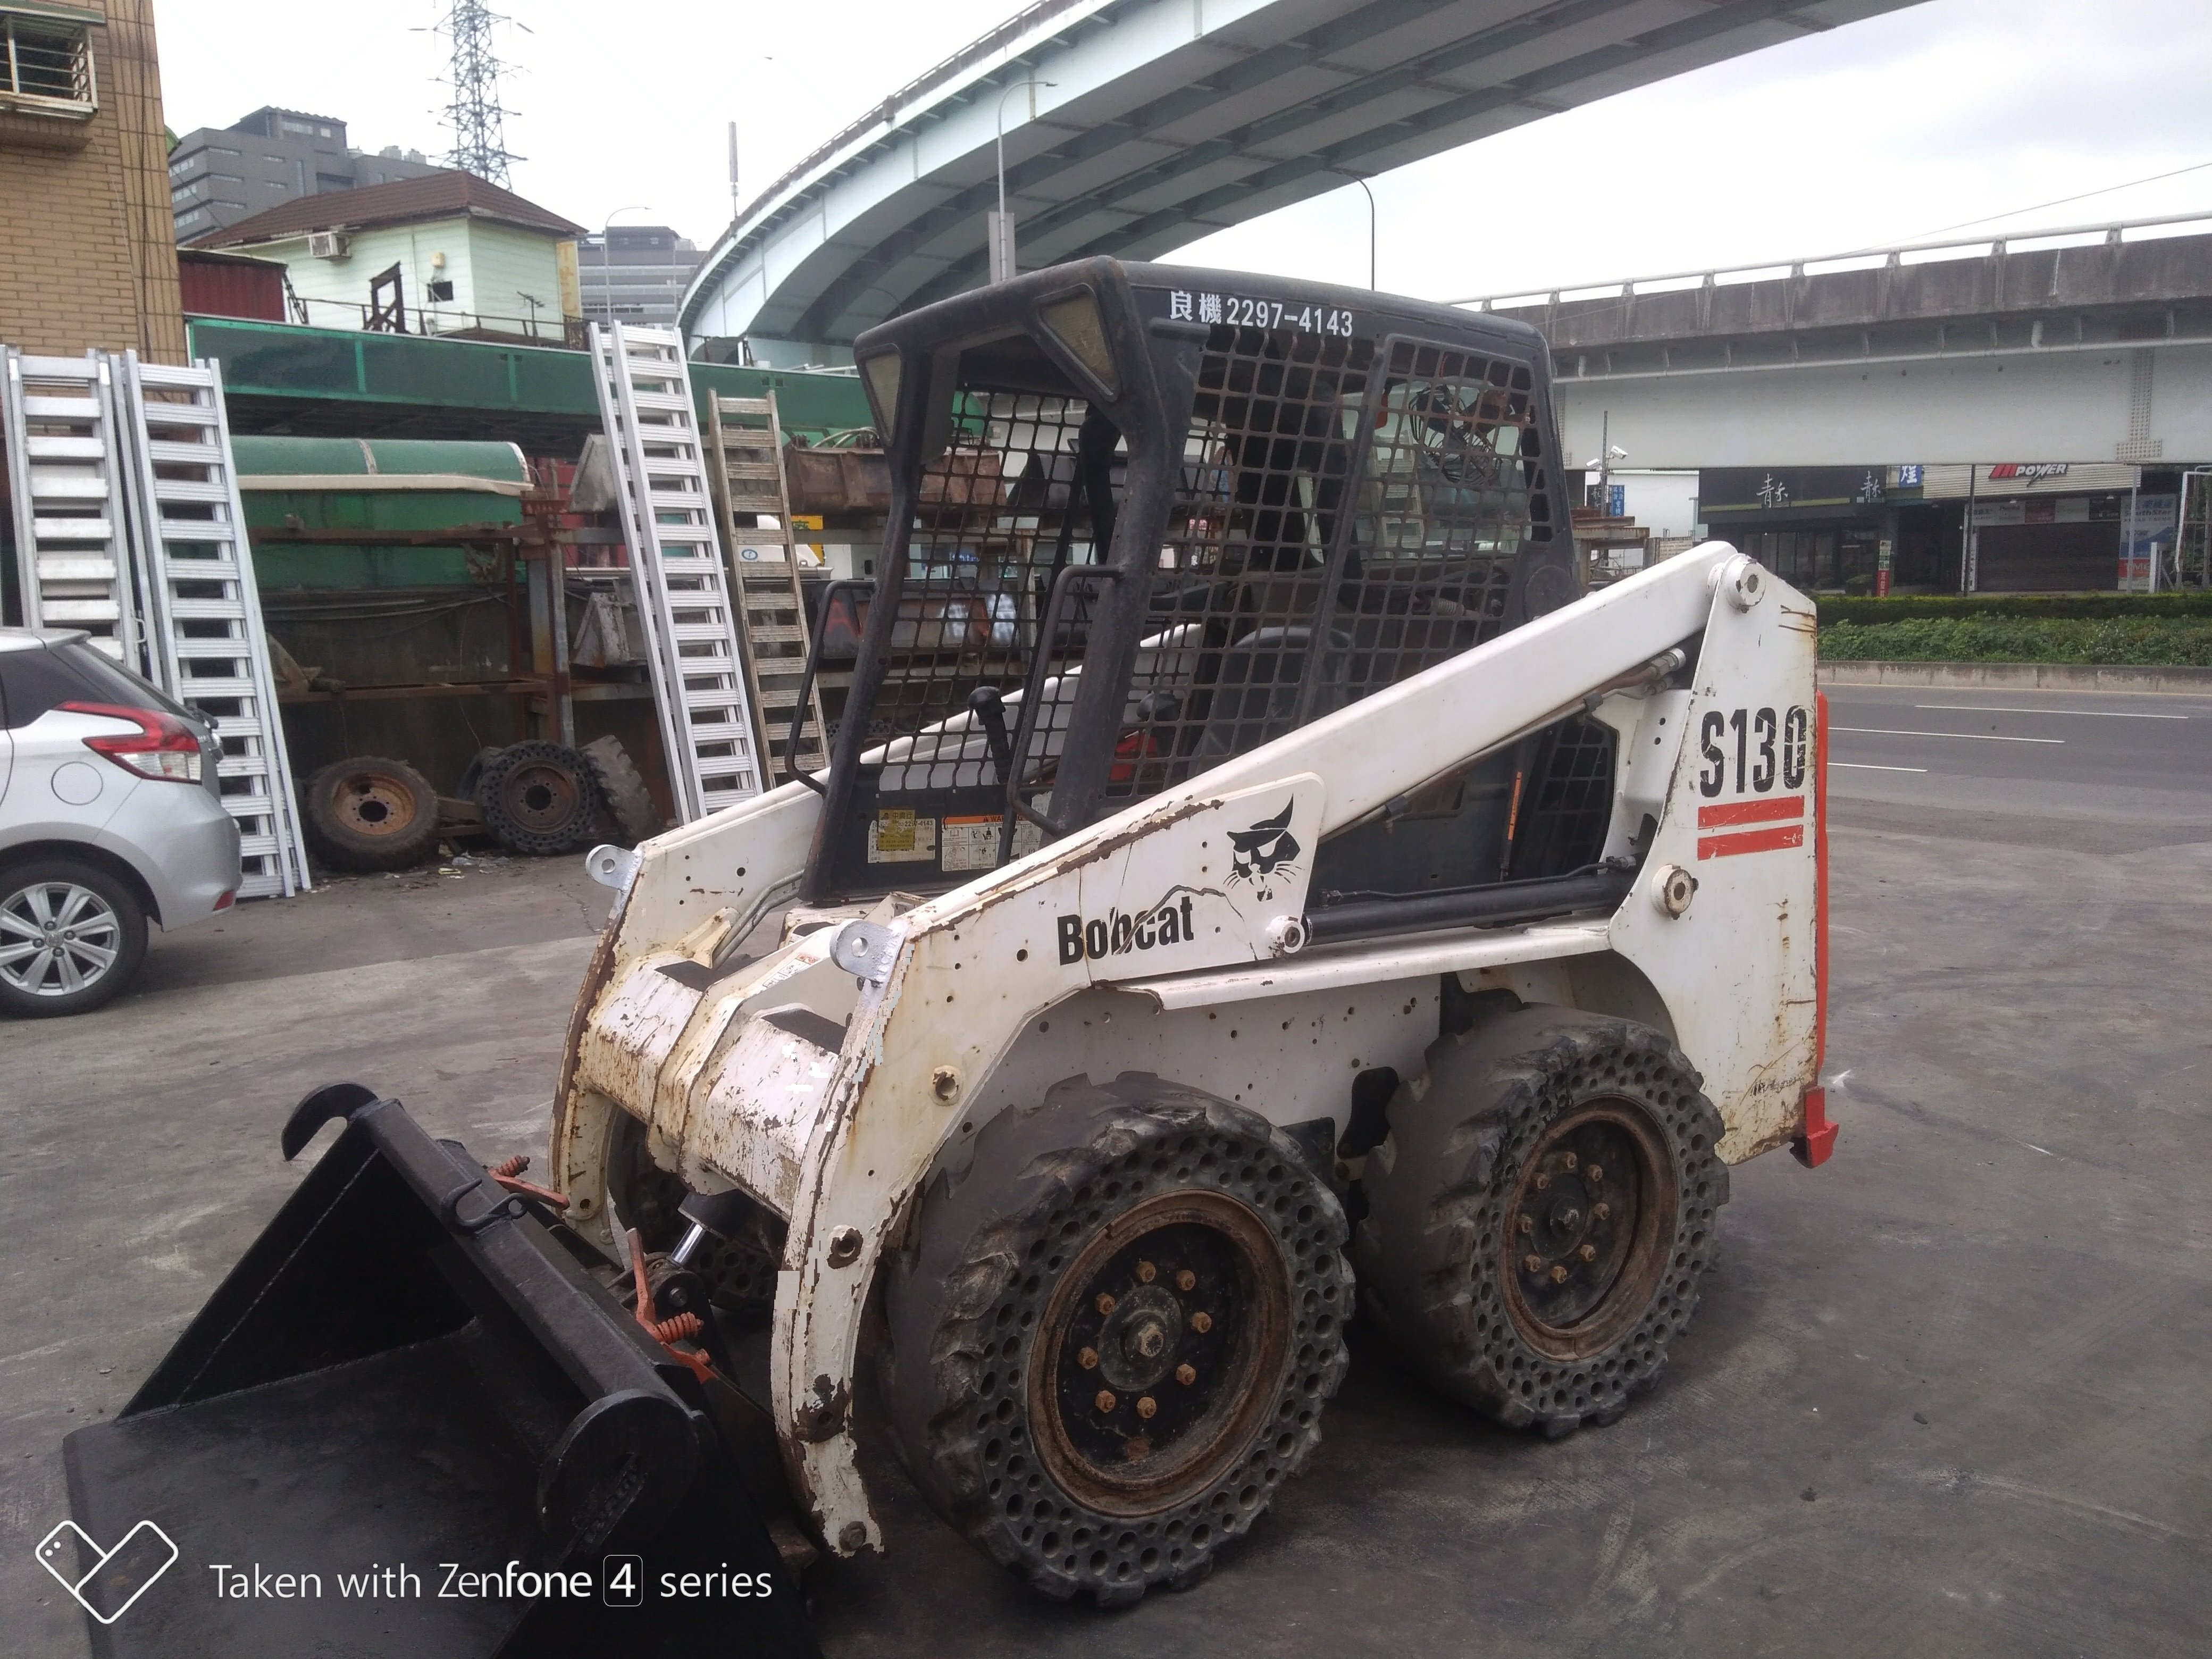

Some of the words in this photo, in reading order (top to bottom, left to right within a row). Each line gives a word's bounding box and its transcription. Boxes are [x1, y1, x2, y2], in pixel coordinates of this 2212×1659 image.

[1170, 290, 1222, 325] 良機
[1226, 297, 1353, 337] 2297-4143
[1699, 705, 1807, 798] S130
[1057, 896, 1194, 966] Bobcat
